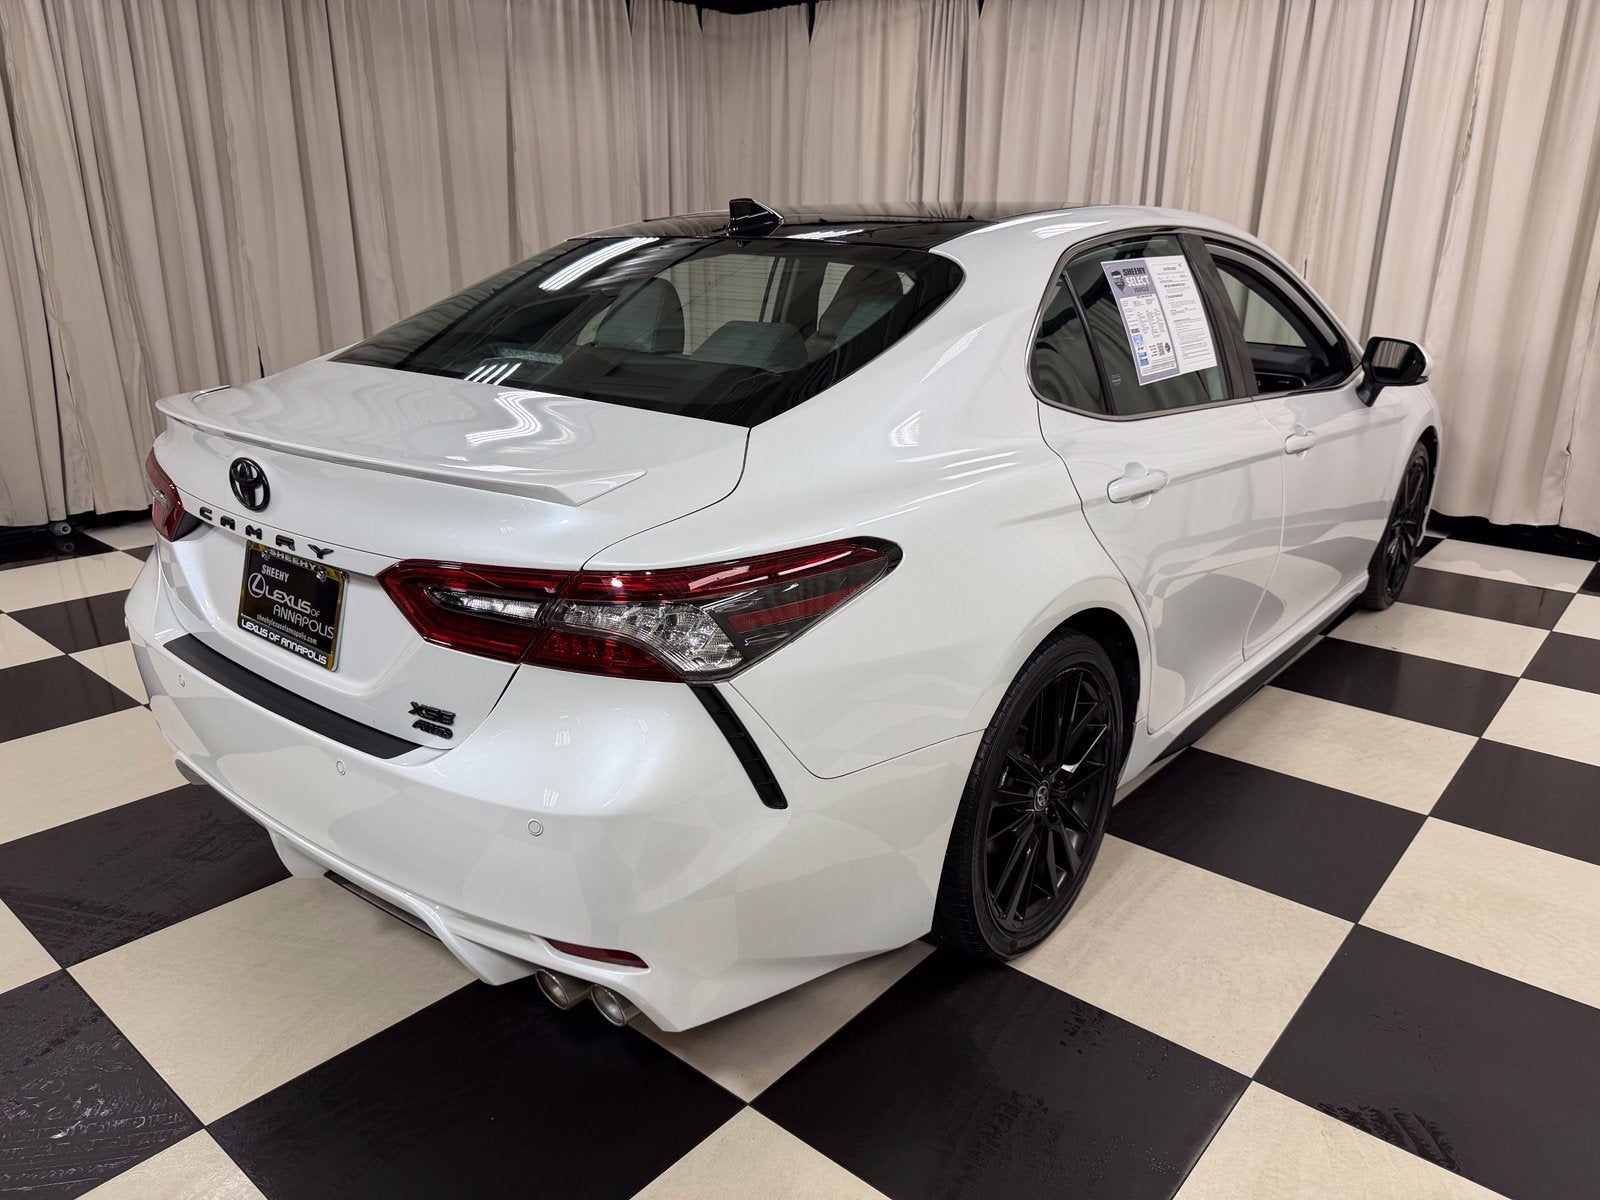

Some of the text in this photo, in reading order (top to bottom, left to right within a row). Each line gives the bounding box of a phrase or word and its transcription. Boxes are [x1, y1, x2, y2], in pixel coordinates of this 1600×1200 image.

[1122, 267, 1146, 276] SHEEHY
[1126, 275, 1150, 287] SELECT
[200, 507, 334, 559] CAMRY
[269, 549, 318, 570] SHEEHY
[261, 564, 289, 582] SHEEHY
[265, 586, 311, 614] LEXUS
[311, 608, 320, 618] OF
[273, 604, 334, 639] ANNAPOLIS
[241, 618, 327, 665] LEXUS OF ANNAPOLIS
[408, 701, 456, 726] XSE
[412, 719, 453, 739] AWD
